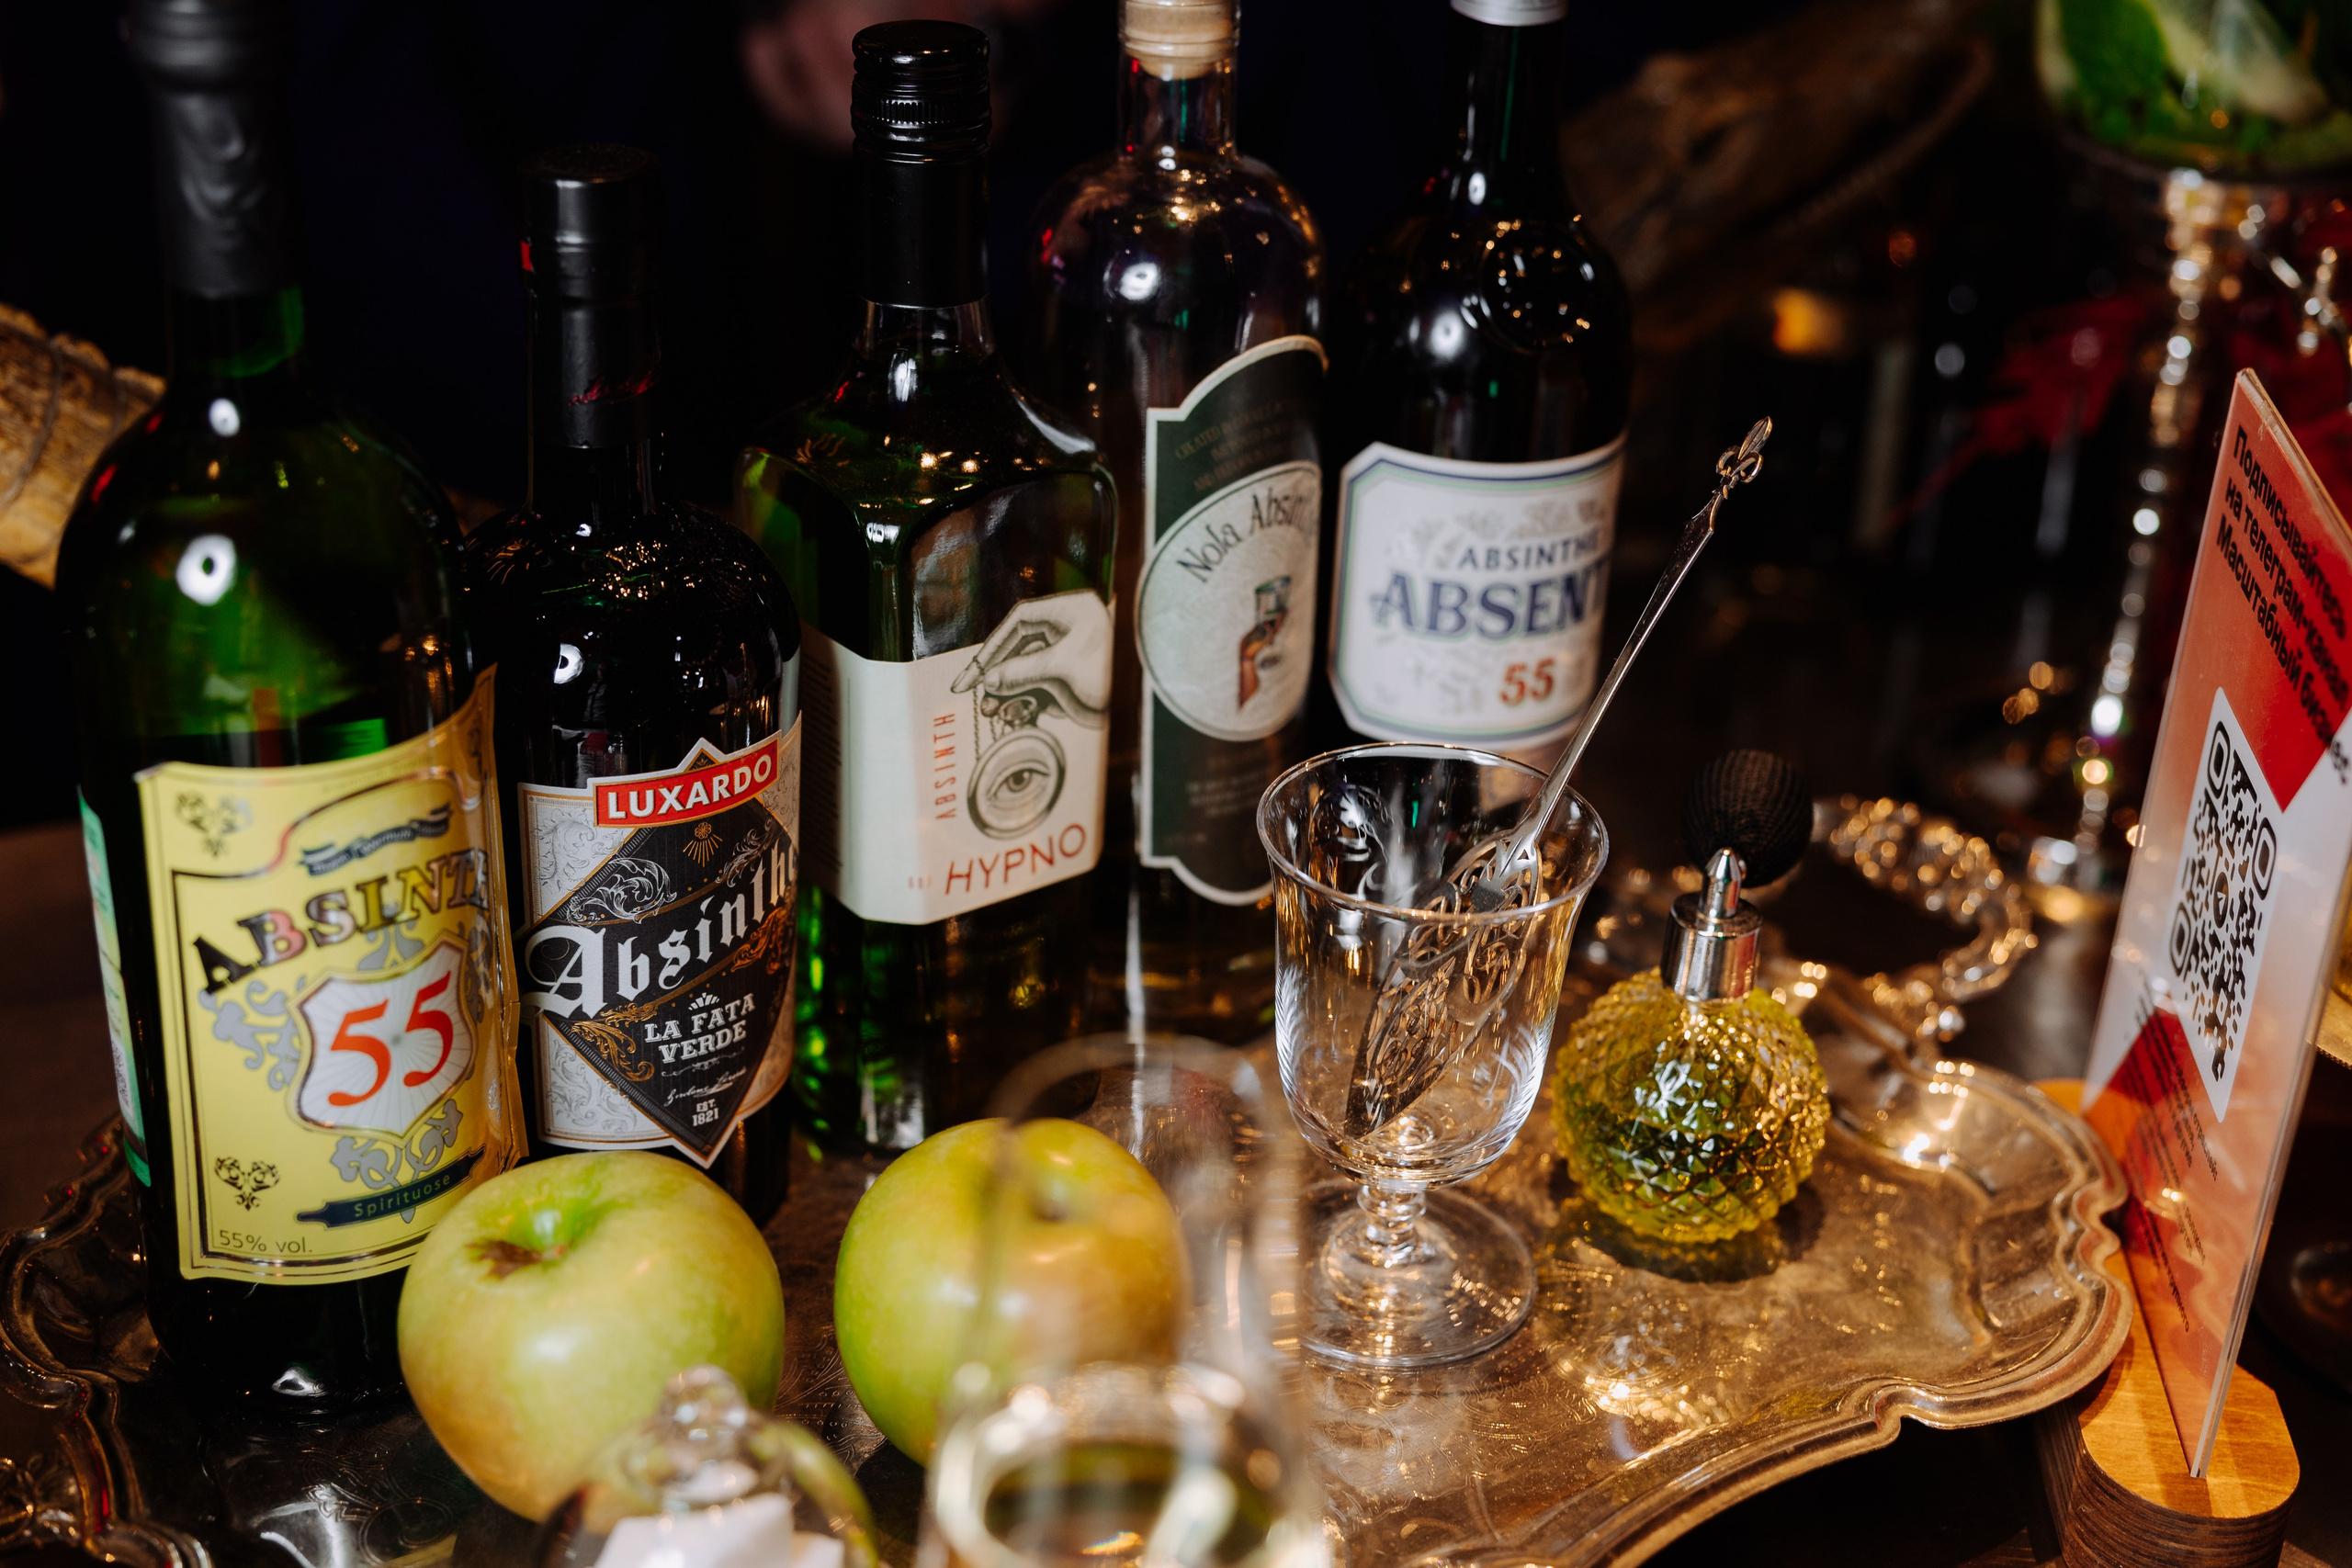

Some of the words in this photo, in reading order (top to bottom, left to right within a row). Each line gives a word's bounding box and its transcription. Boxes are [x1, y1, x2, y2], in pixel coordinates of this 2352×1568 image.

[2225, 477, 2243, 523] на
[1176, 523, 1242, 585] Nola
[2217, 512, 2303, 692] Масштабный
[1499, 658, 1556, 706] 55
[607, 753, 772, 820] LUXARDO
[933, 713, 956, 820] ABSINTH
[944, 823, 1087, 897] HYPNO
[327, 969, 454, 1108] 55
[644, 1020, 682, 1043] LA
[691, 993, 755, 1034] FATA
[658, 1020, 747, 1064] VERDE
[692, 1107, 719, 1127] 1821
[354, 1172, 451, 1218] Spirituose
[219, 1229, 266, 1253] 55%
[276, 1236, 313, 1254] vol.
